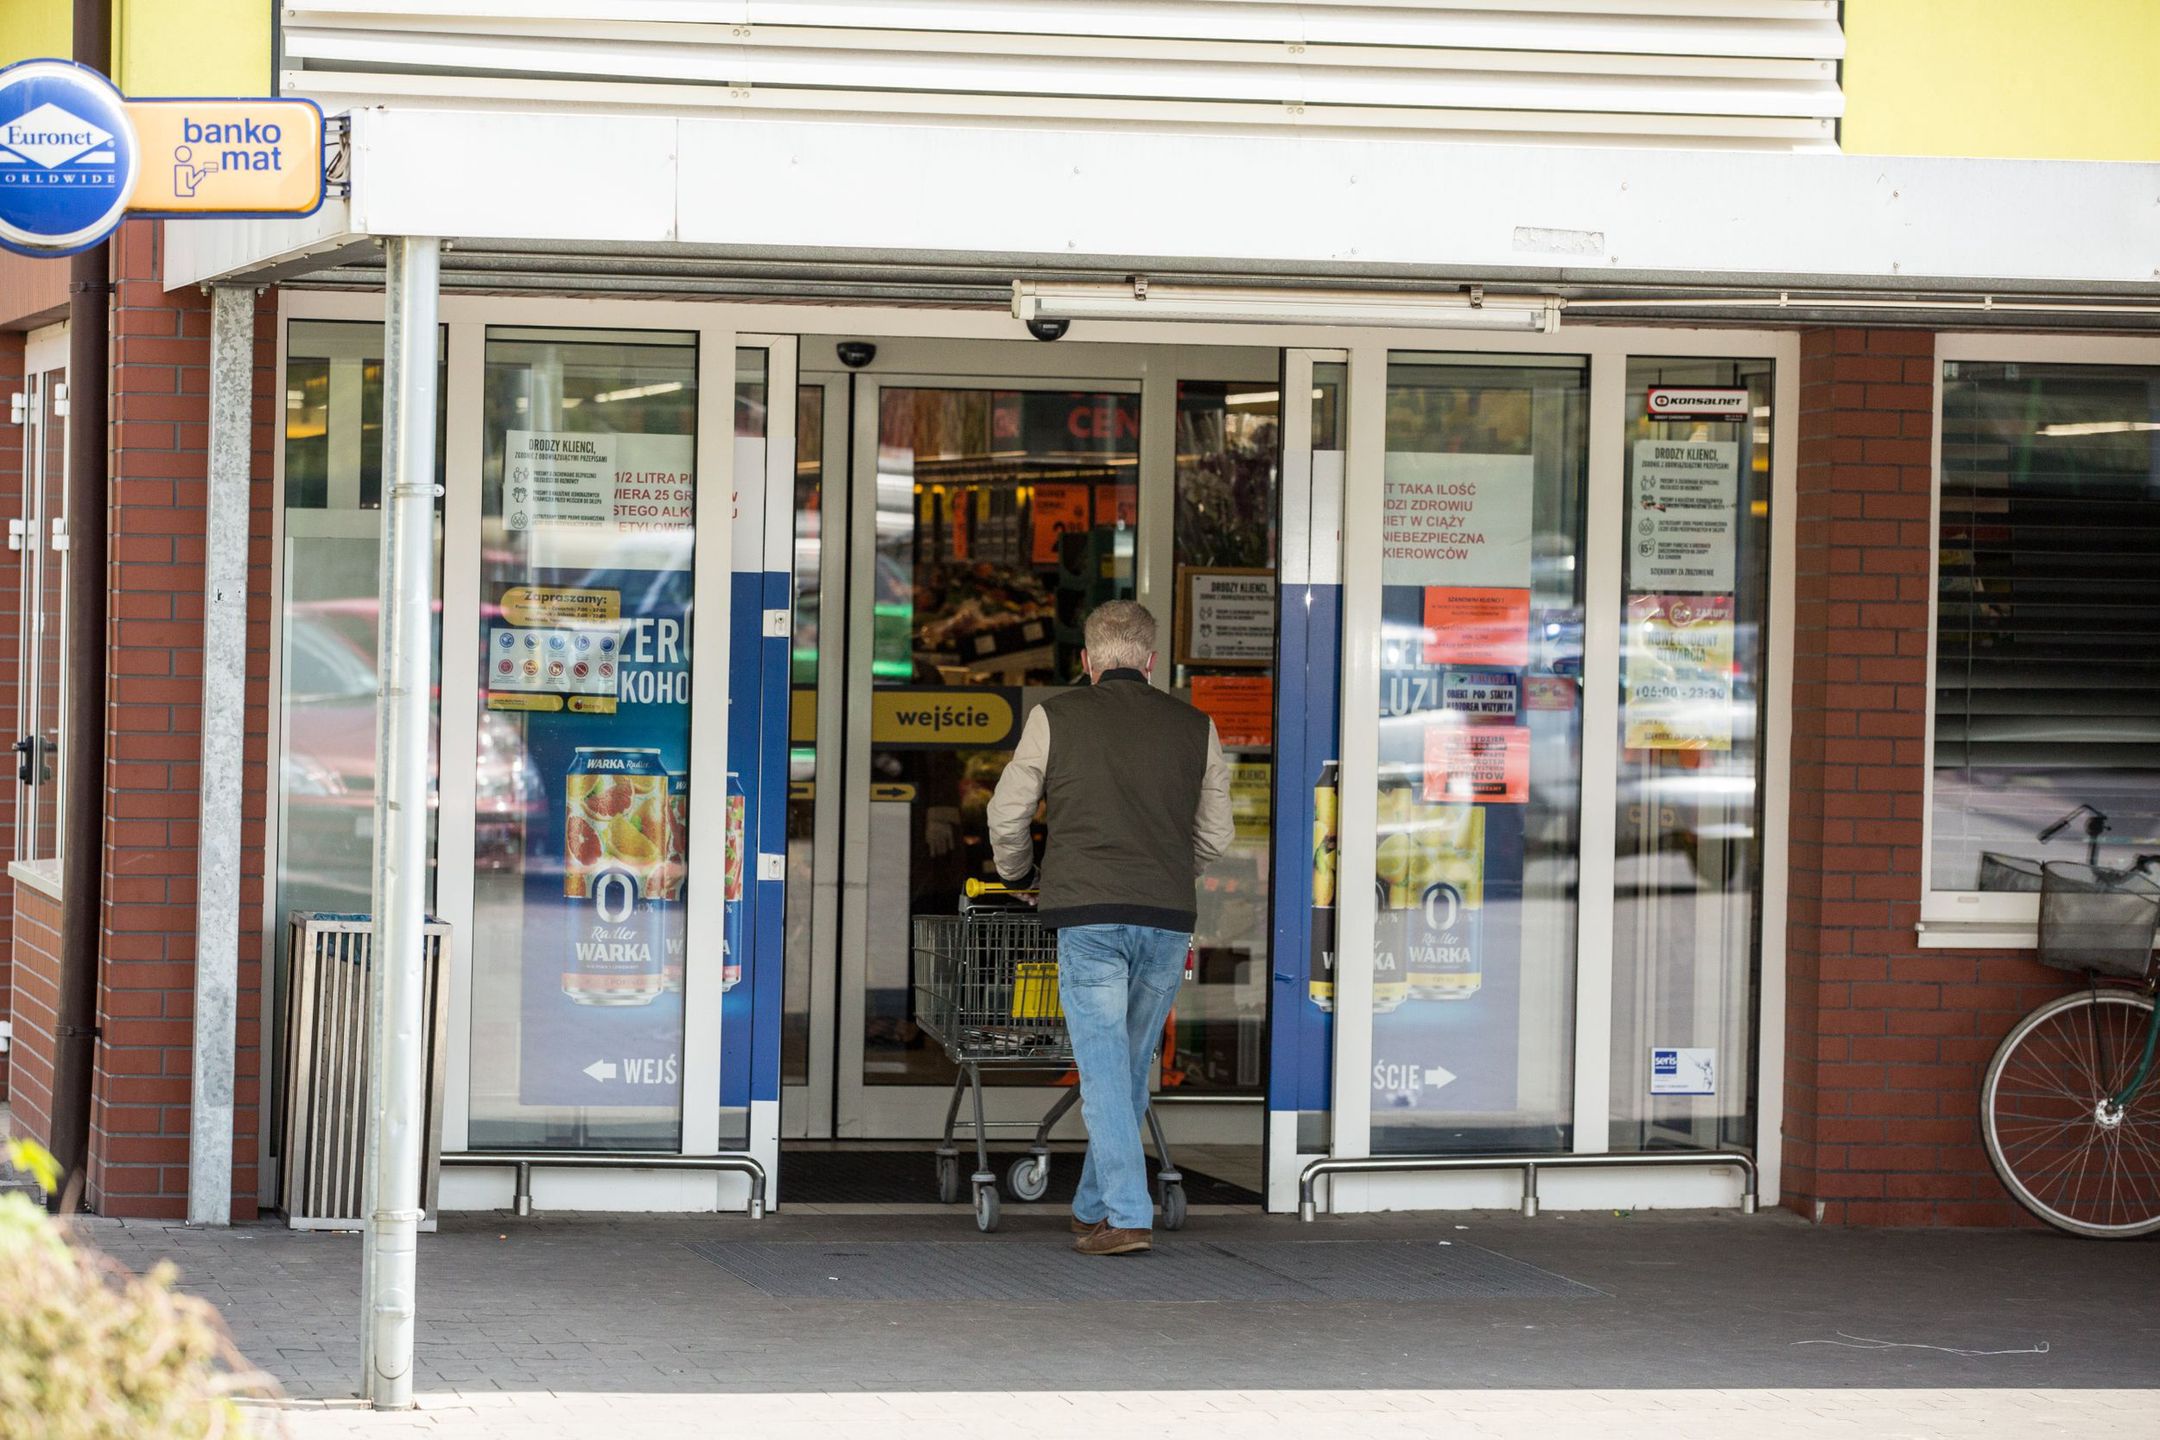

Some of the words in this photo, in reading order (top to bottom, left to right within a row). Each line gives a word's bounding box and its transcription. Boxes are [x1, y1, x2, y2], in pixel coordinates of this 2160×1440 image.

[7, 126, 93, 145] Euronet
[183, 118, 281, 144] banko
[221, 147, 281, 171] mat
[636, 473, 676, 484] LITRA
[655, 490, 670, 500] 25
[1398, 483, 1433, 495] TAKA
[1437, 482, 1476, 496] ILOŚĆ
[1411, 500, 1473, 512] ZDROWIU
[1411, 516, 1422, 527] W
[1426, 514, 1465, 530] CIĄŻY
[524, 590, 608, 607] Zapraszamy:
[1472, 690, 1486, 699] POD
[896, 707, 989, 732] wejście
[587, 759, 625, 769] WARKA
[576, 942, 651, 962] WARKA
[1409, 946, 1473, 963] WARKA
